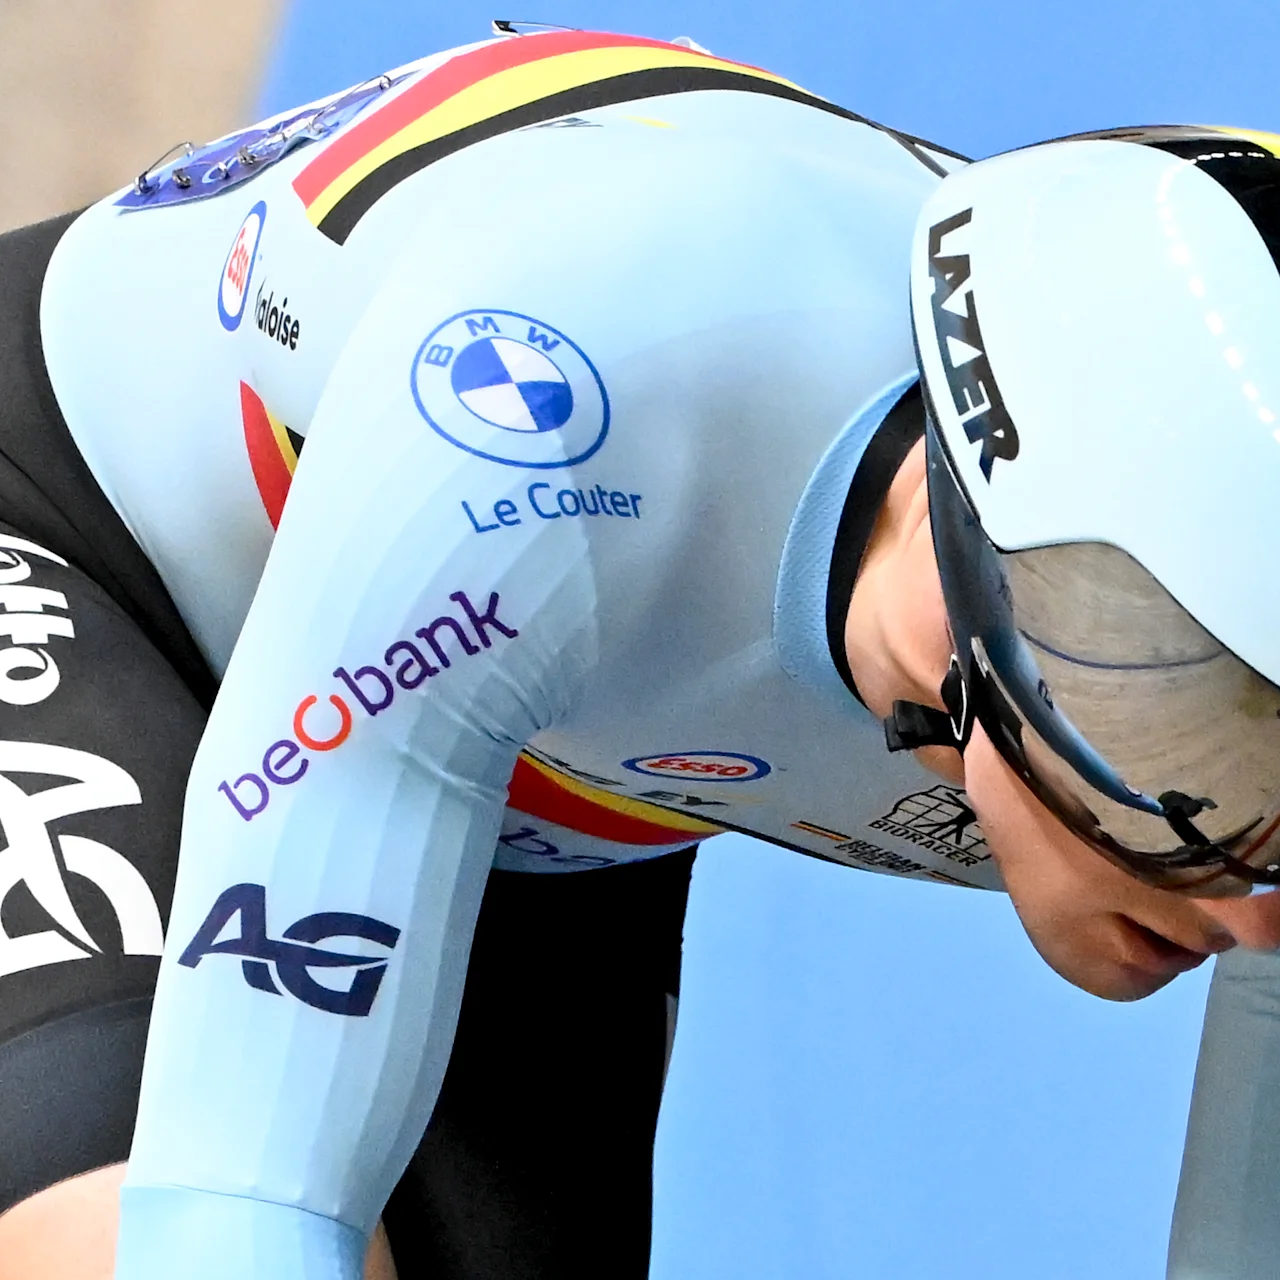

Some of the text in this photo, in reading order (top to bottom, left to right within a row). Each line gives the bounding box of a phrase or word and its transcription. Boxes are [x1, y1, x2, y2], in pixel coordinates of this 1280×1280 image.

[423, 316, 562, 368] BMW
[927, 206, 1020, 486] LAZER
[461, 482, 642, 533] Le Couter
[868, 819, 979, 868] BIORACER
[178, 883, 401, 1017] AG
